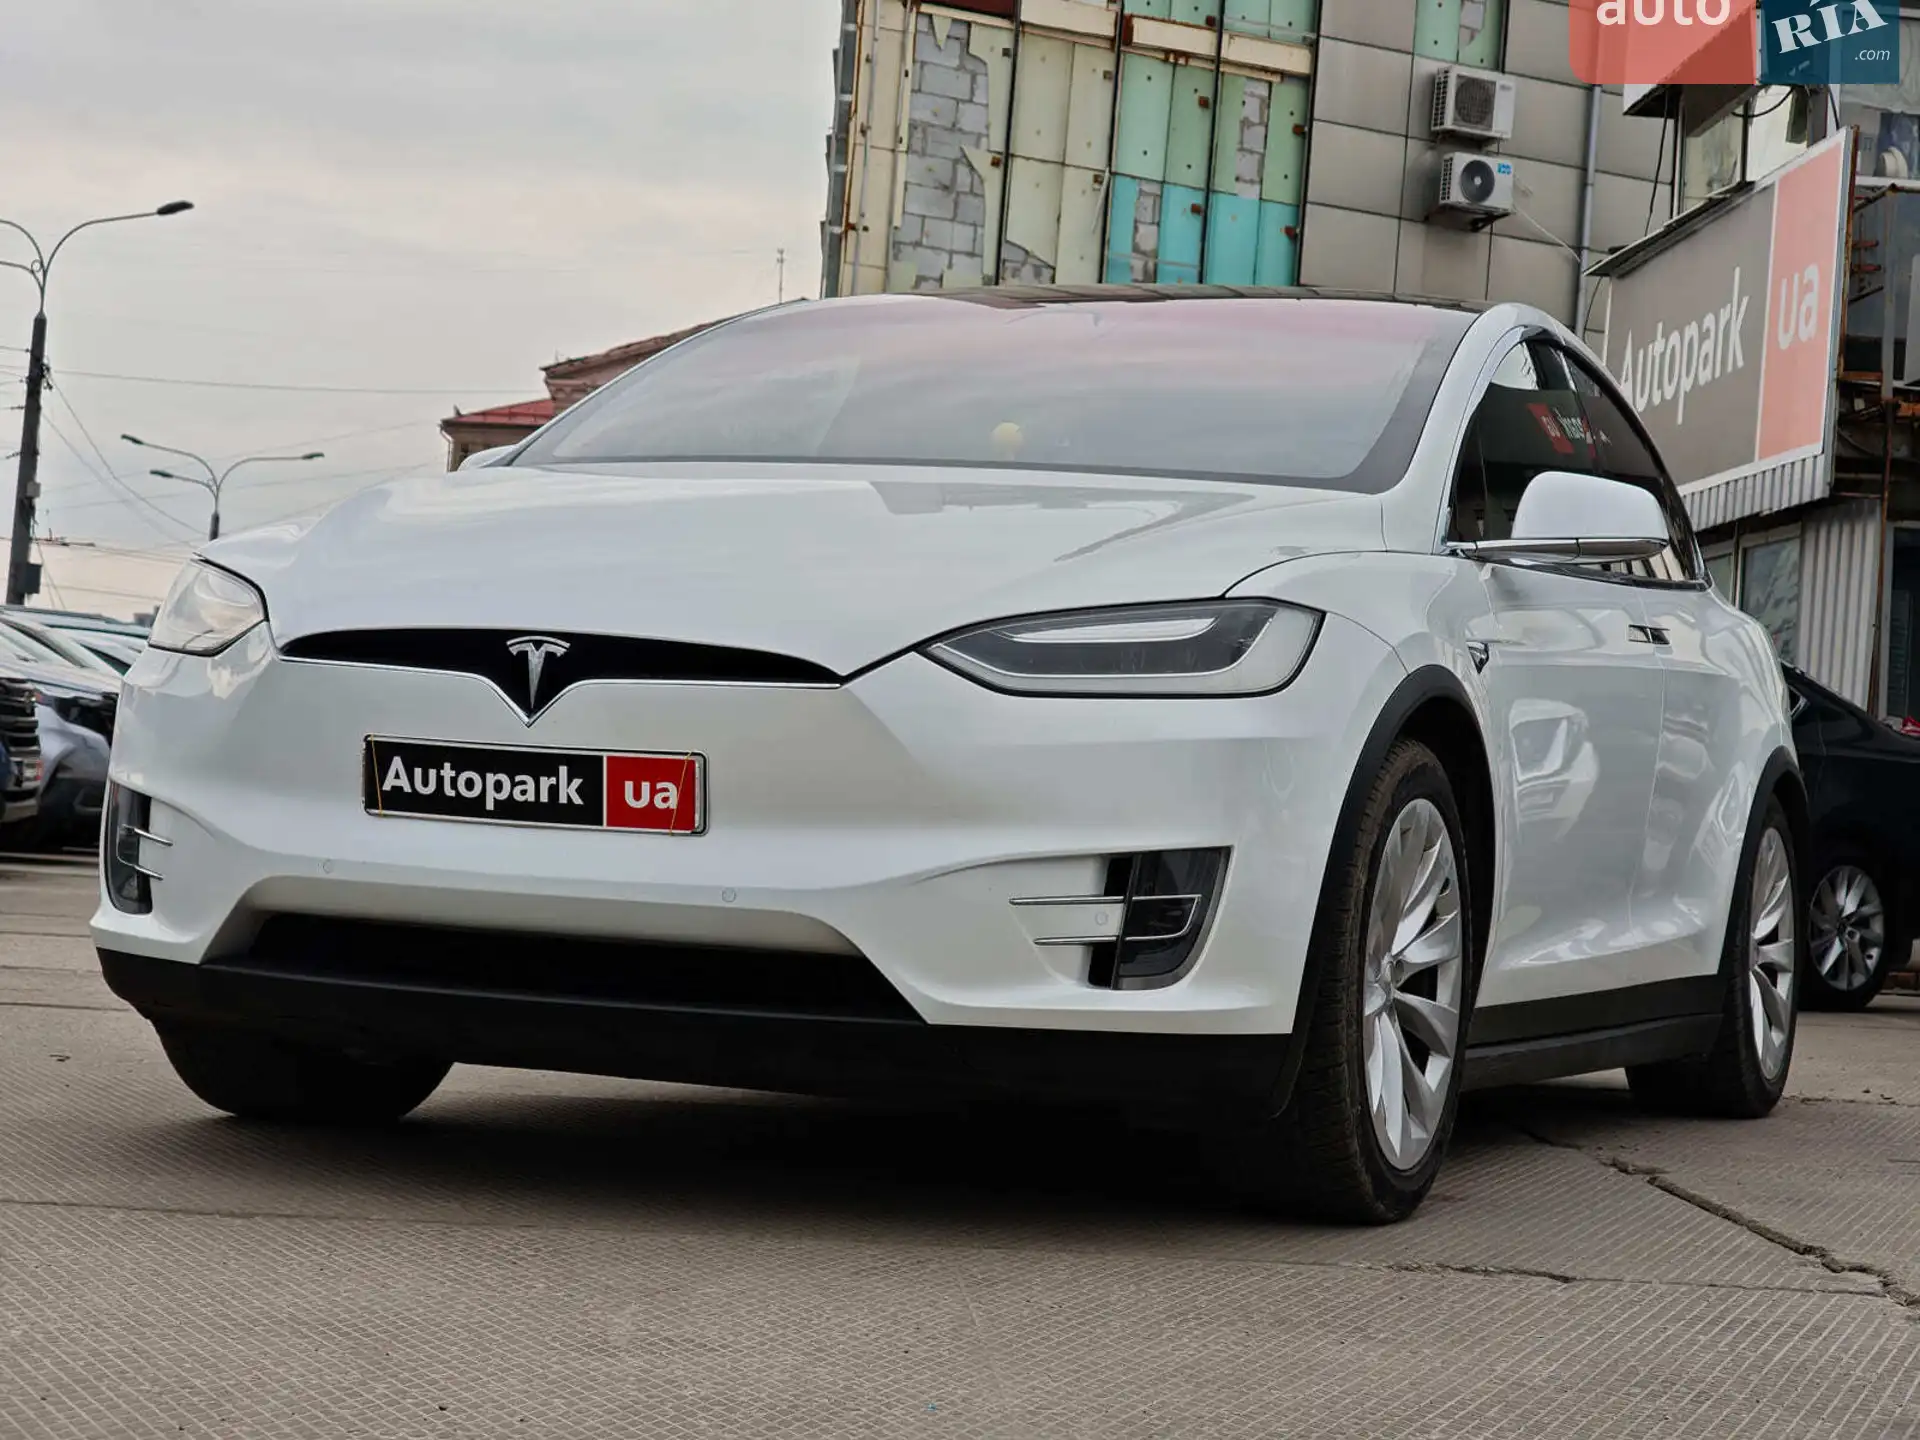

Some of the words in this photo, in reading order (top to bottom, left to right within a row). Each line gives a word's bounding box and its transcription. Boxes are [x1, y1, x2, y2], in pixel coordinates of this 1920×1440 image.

[1619, 266, 1749, 425] Autopark
[1777, 263, 1819, 350] ua
[381, 756, 584, 811] Autopark
[623, 780, 679, 809] ua
